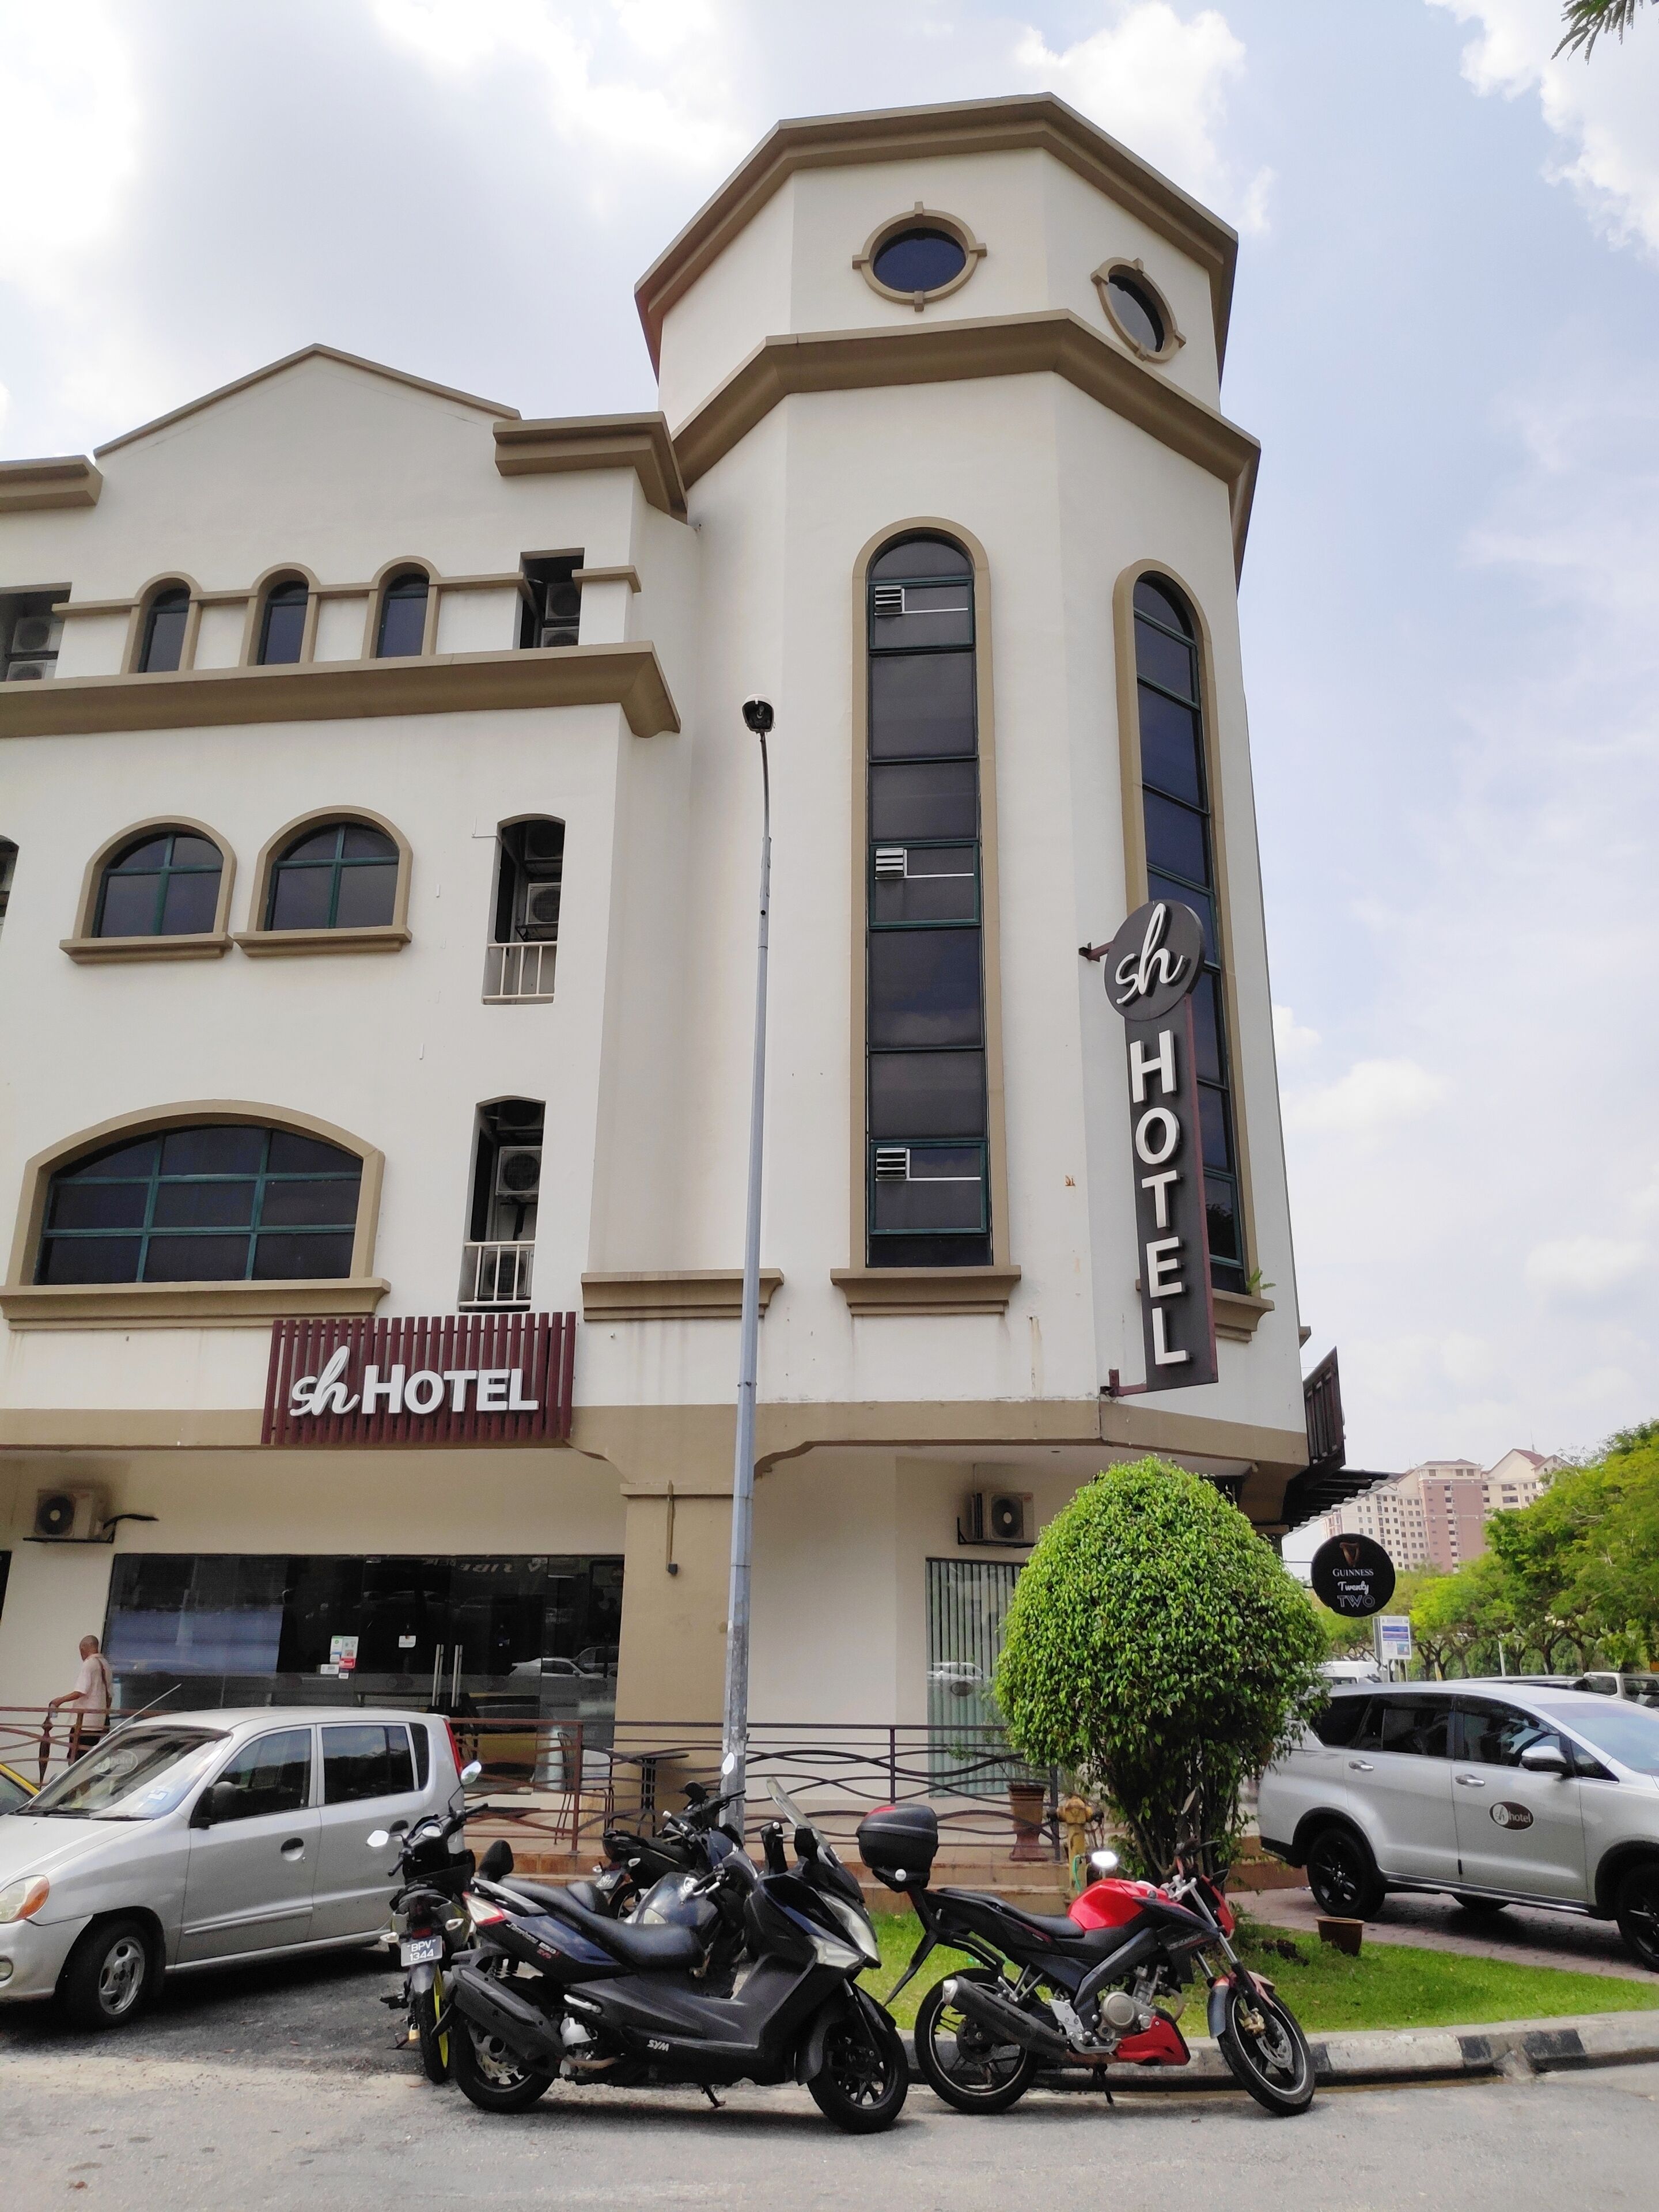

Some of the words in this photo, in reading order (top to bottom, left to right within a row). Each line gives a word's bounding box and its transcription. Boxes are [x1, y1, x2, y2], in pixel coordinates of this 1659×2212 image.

[1115, 903, 1187, 1005] sh
[1130, 1029, 1189, 1366] HOTEL
[290, 1345, 361, 1416] sh
[362, 1363, 539, 1415] HOTEL
[1332, 1568, 1374, 1577] GUINNESS
[1337, 1580, 1369, 1595] Twenty
[1337, 1594, 1376, 1608] TWO
[1509, 1810, 1531, 1823] hotel
[411, 1940, 432, 1952] BPV
[410, 1948, 434, 1961] 1344
[646, 2039, 669, 2052] SYM
